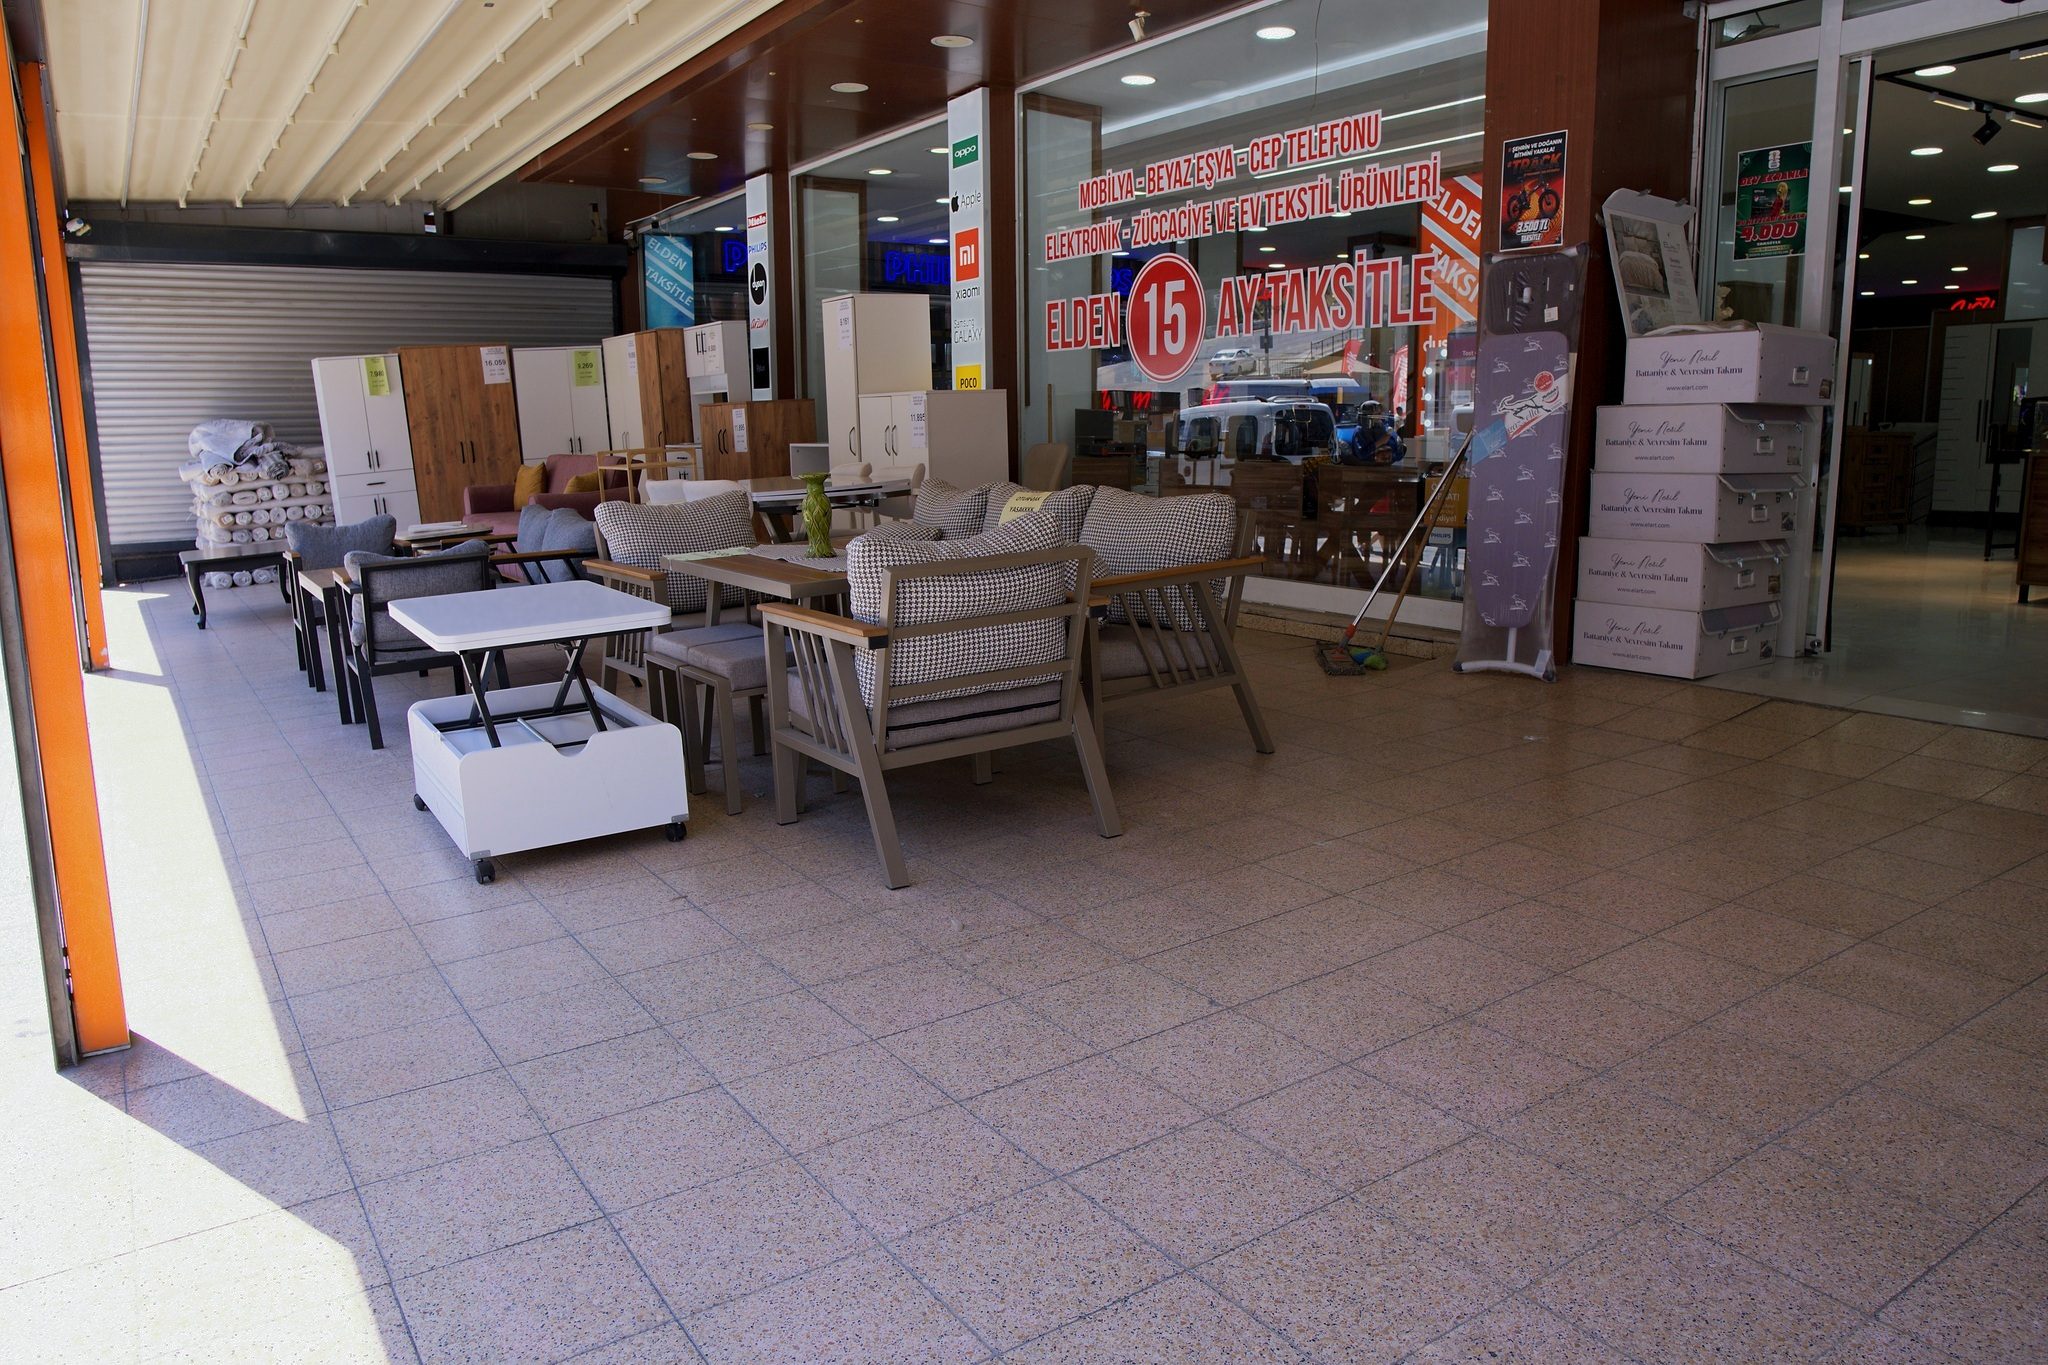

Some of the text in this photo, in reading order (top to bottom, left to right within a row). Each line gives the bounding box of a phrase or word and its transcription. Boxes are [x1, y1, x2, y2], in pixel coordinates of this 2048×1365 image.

[954, 144, 977, 158] oppo
[1079, 169, 1135, 211] MOBİLYA
[1146, 157, 1194, 198] BEYAZ
[1194, 144, 1236, 190] EŞYA
[1248, 139, 1284, 175] CEP
[1285, 109, 1382, 166] TELEFONU
[960, 190, 982, 209] Apple
[1045, 213, 1122, 263] ELEKTRONİK
[1131, 199, 1213, 249] ZÜCCACİYE
[1214, 195, 1239, 233] VE
[1238, 190, 1264, 231] EV
[1264, 174, 1336, 226] TEKSTİL
[1338, 151, 1441, 213] ÜRÜNLERİ
[1427, 186, 1480, 240] ELDE
[1740, 221, 1799, 242] 4.000
[647, 237, 687, 272] ELDEN
[748, 242, 768, 254] PHILIPS
[646, 266, 694, 307] TAKSİTLE
[955, 286, 981, 299] xiaomi
[1045, 249, 1437, 356] ELDEN 15 AY TAKSİTLE
[954, 327, 983, 344] GALAXY
[1635, 366, 1743, 378] Battaniye & Nevresim Takımı
[960, 377, 977, 389] POCO
[1605, 438, 1637, 447] Battaniye
[1646, 438, 1680, 446] Nevresim
[1682, 438, 1708, 446] Takımı
[1601, 504, 1633, 513] Battaniye
[1641, 506, 1676, 515] Nevresim
[1678, 506, 1703, 515] Takımı
[1588, 568, 1688, 583] Battaniye & Nevresim Takımı
[1583, 632, 1684, 650] Battaniye & Nevresim Takımı
